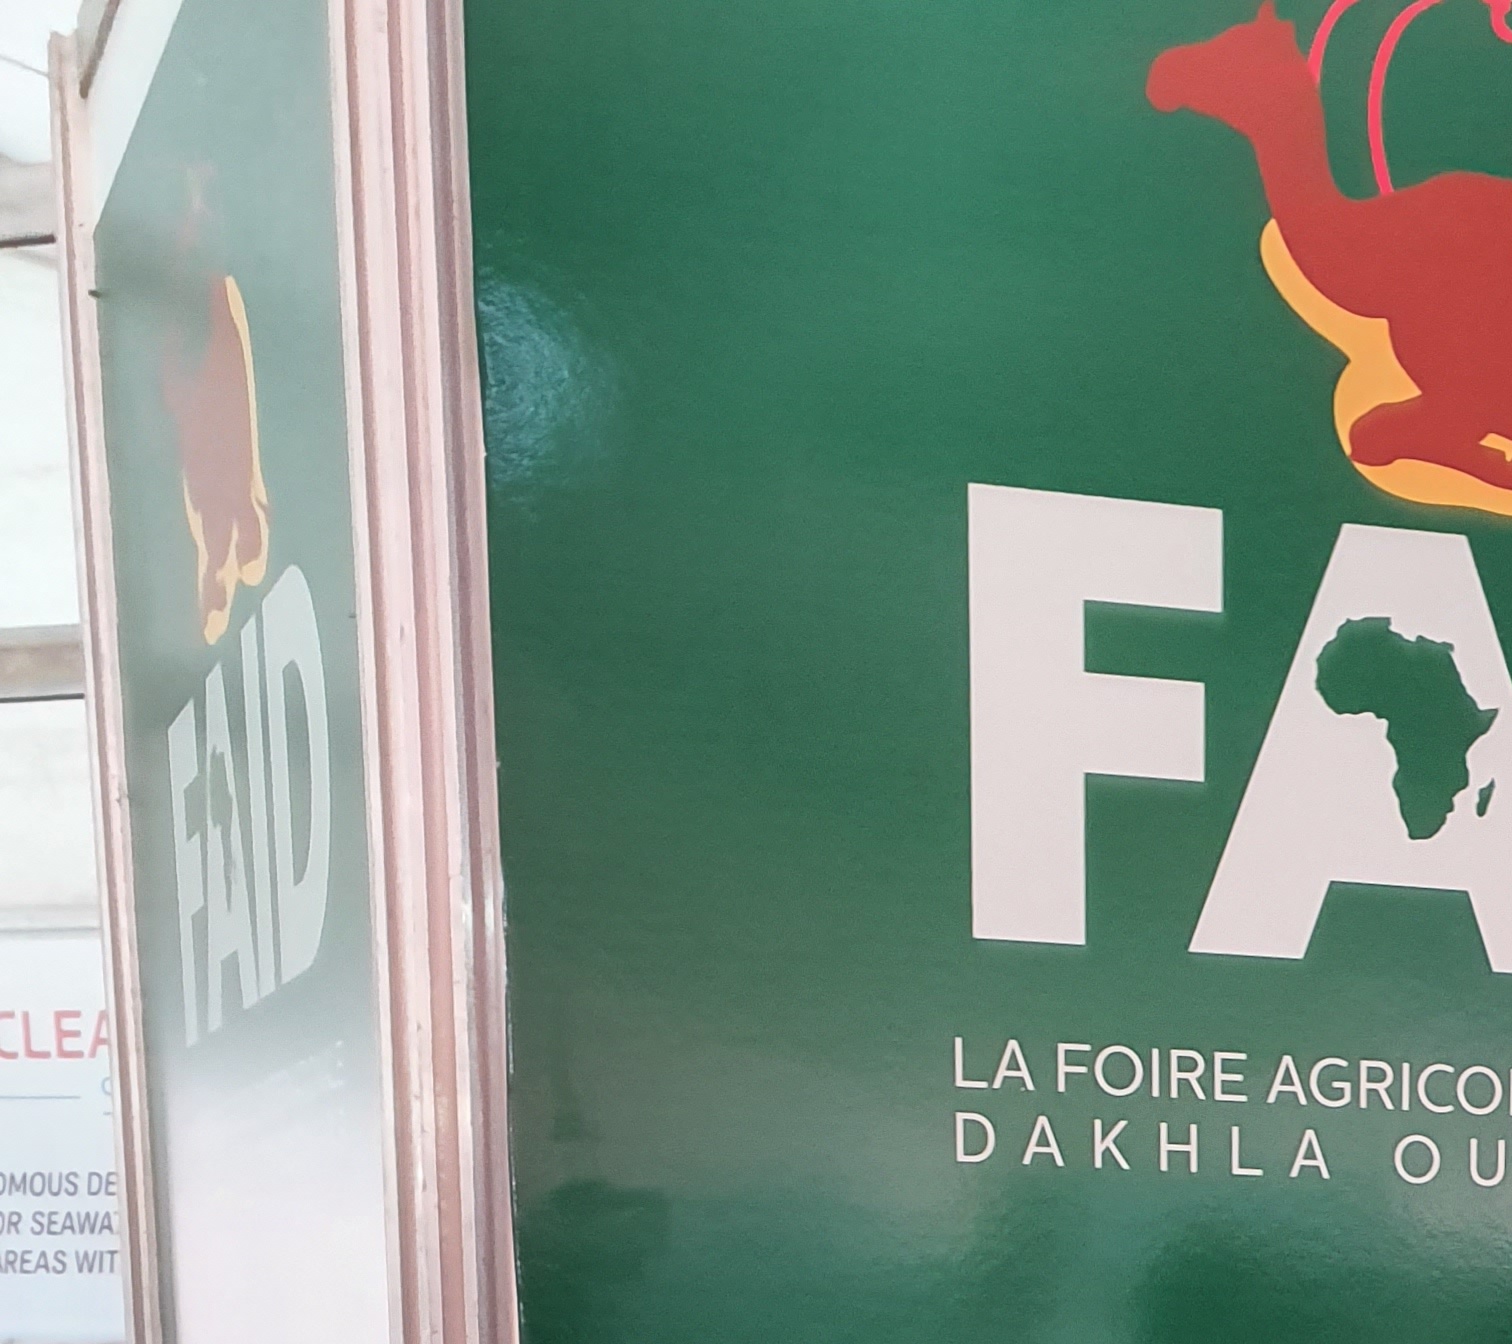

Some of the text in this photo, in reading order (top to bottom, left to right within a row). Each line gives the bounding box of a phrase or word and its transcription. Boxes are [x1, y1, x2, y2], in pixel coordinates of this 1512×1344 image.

[168, 564, 331, 1048] FAID
[954, 1036, 1036, 1091] LA
[1056, 1042, 1249, 1103] FOIRE
[954, 1111, 1331, 1180] DAKHLA
[30, 1210, 119, 1236] SEAWA
